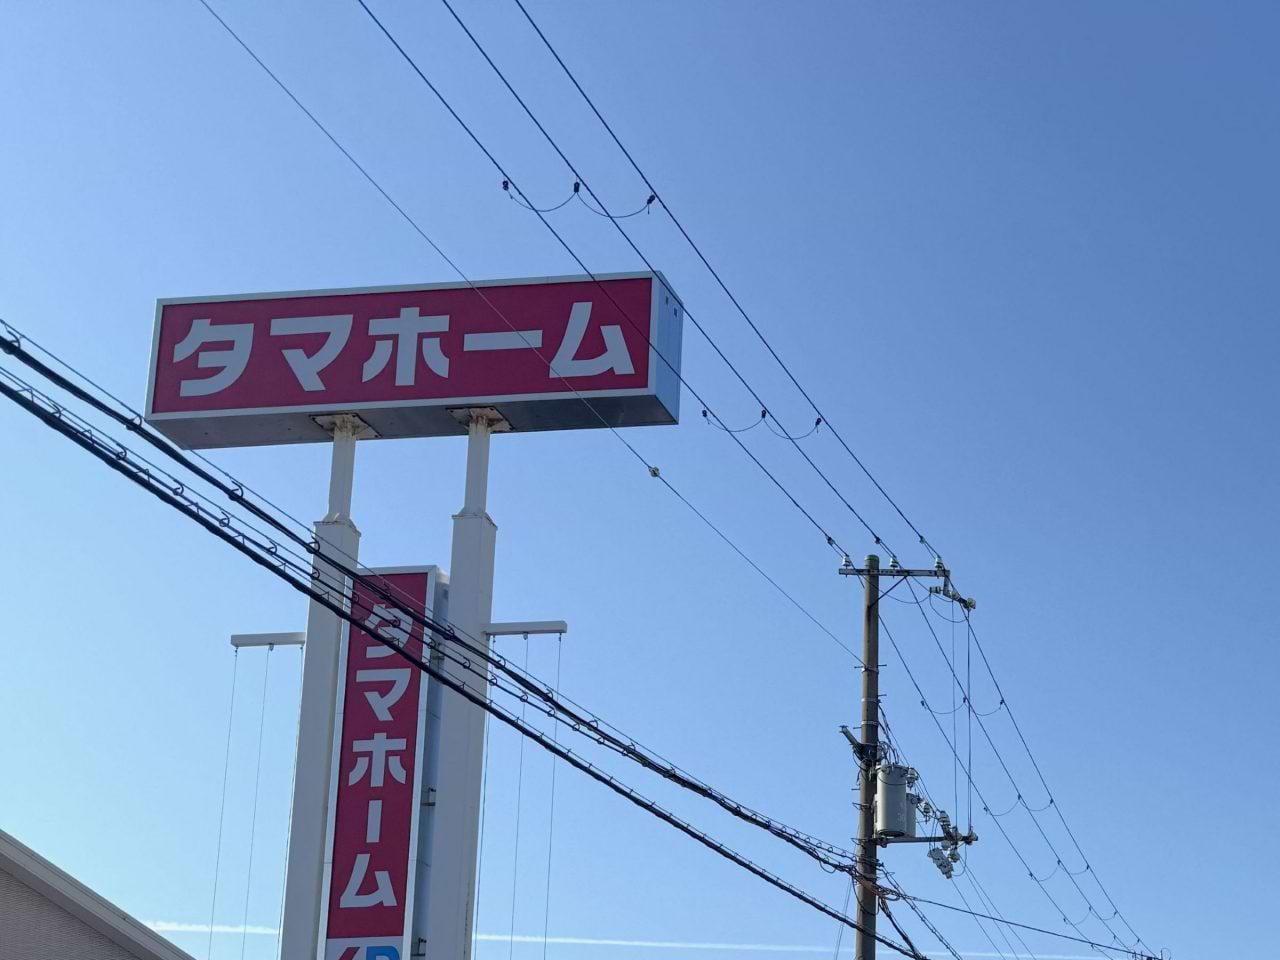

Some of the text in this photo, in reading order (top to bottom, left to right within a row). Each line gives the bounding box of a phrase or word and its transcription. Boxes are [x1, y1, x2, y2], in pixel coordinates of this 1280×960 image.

[172, 301, 635, 397] タマホーム
[339, 603, 415, 909] タマホーム
